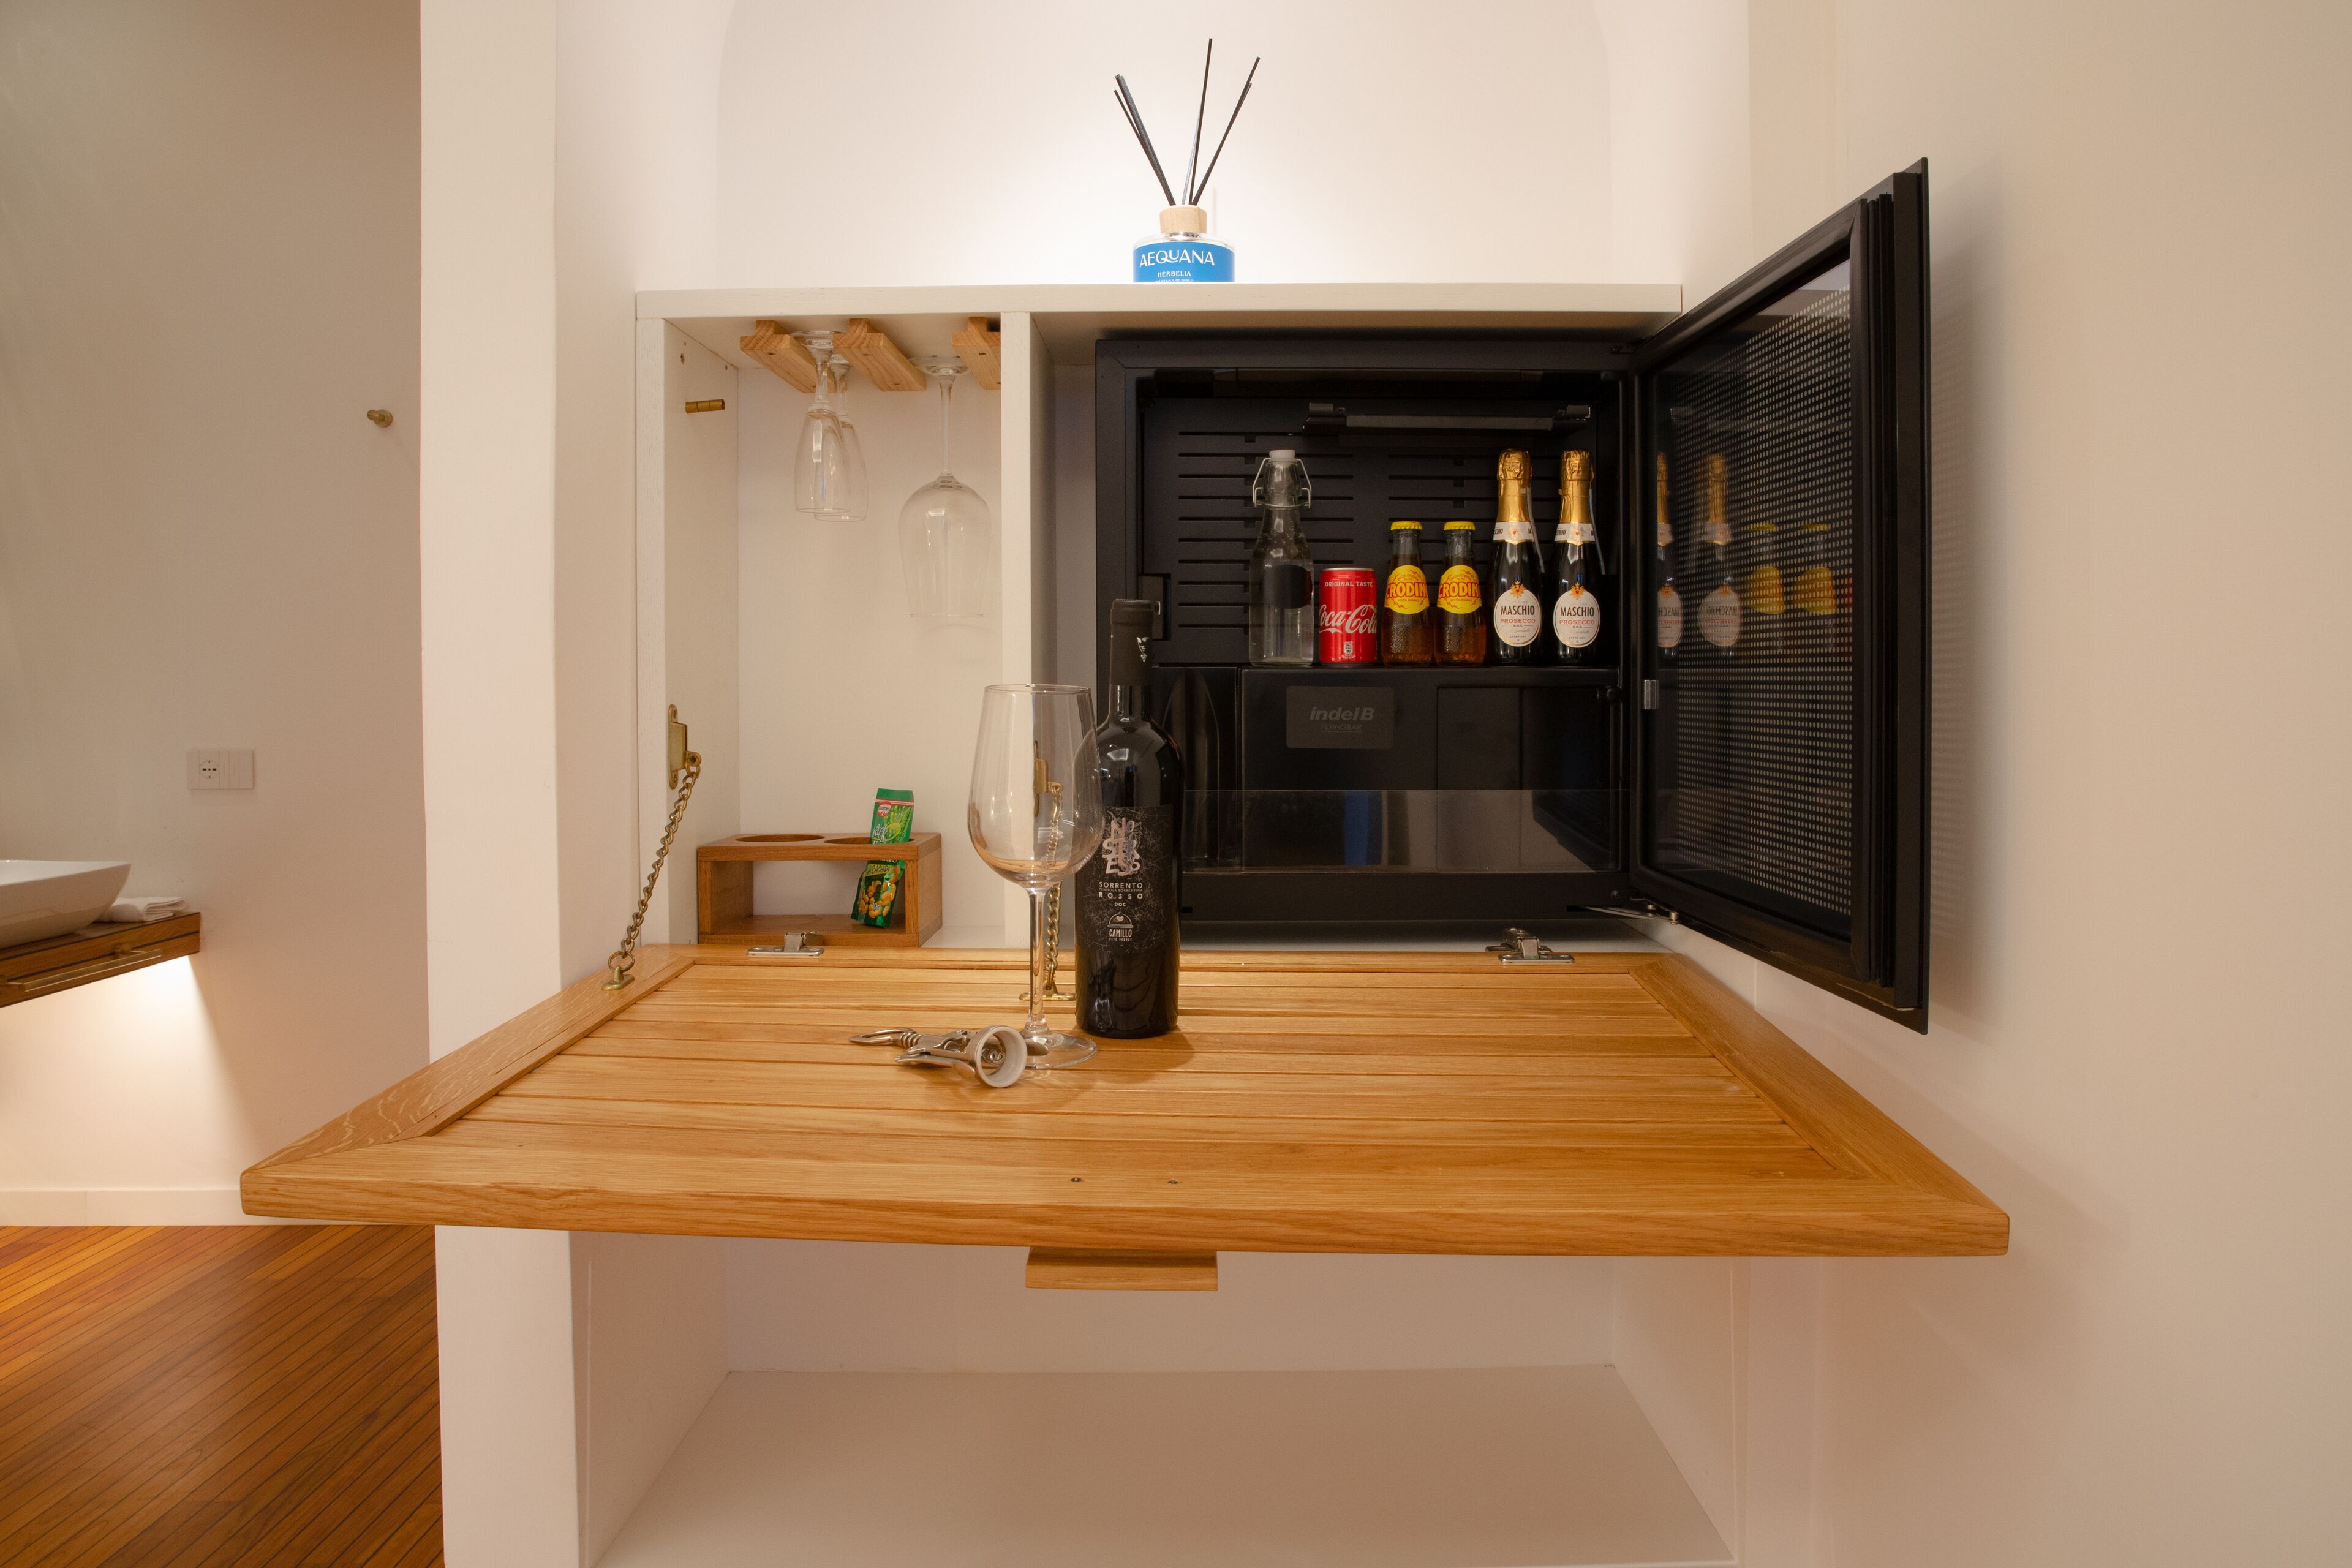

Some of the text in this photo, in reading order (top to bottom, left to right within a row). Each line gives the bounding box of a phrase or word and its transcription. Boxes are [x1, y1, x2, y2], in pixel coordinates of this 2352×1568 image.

[1139, 249, 1215, 268] AEQUANA
[1386, 581, 1429, 599] CRODIN
[1438, 581, 1481, 599] CRODIN
[1319, 604, 1378, 634] Coca-Cola
[1501, 605, 1535, 615] MASCHIO
[1560, 606, 1594, 617] MASCHIO
[1109, 929, 1133, 937] CAMILLO
